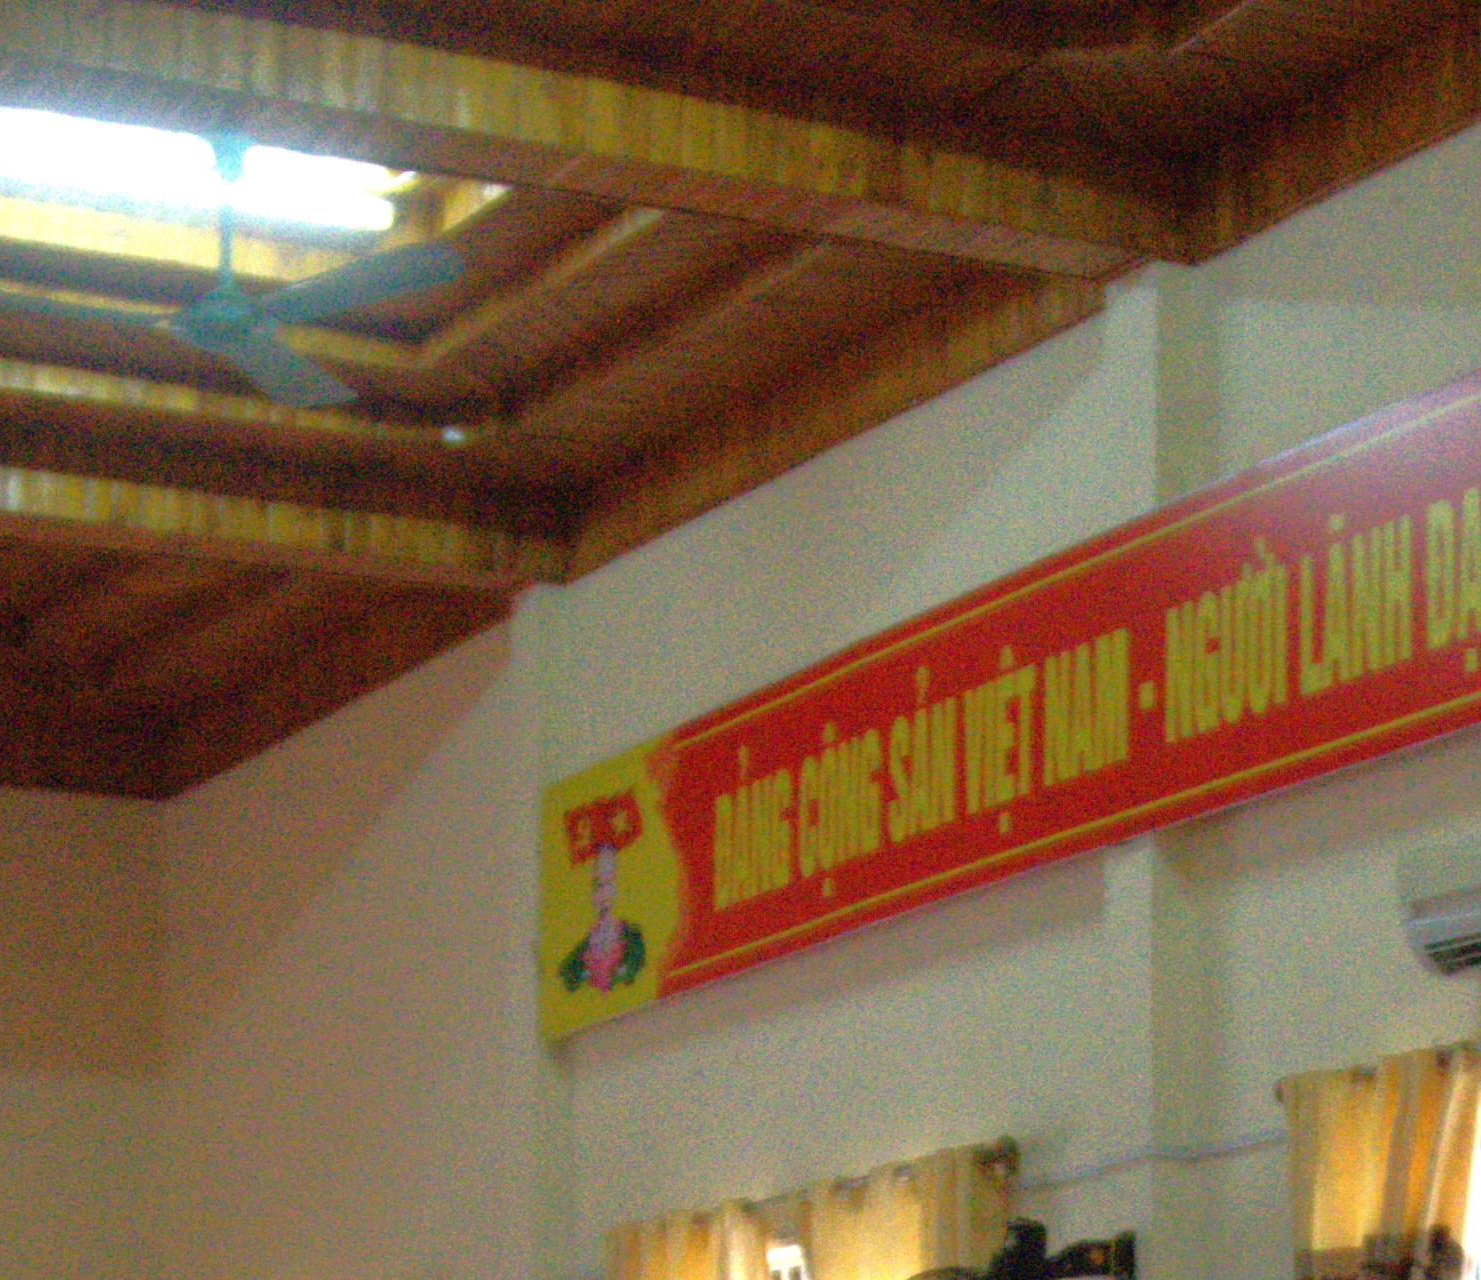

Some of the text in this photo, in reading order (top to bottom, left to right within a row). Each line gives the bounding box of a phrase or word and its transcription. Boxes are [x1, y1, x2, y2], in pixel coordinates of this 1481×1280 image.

[798, 721, 881, 897] CỘNG
[889, 665, 956, 844] SẢN
[964, 645, 1037, 835] VIỆT
[1043, 627, 1130, 786] NAM
[1166, 536, 1287, 744] NGƯỜI
[1300, 513, 1412, 697] LÃNH
